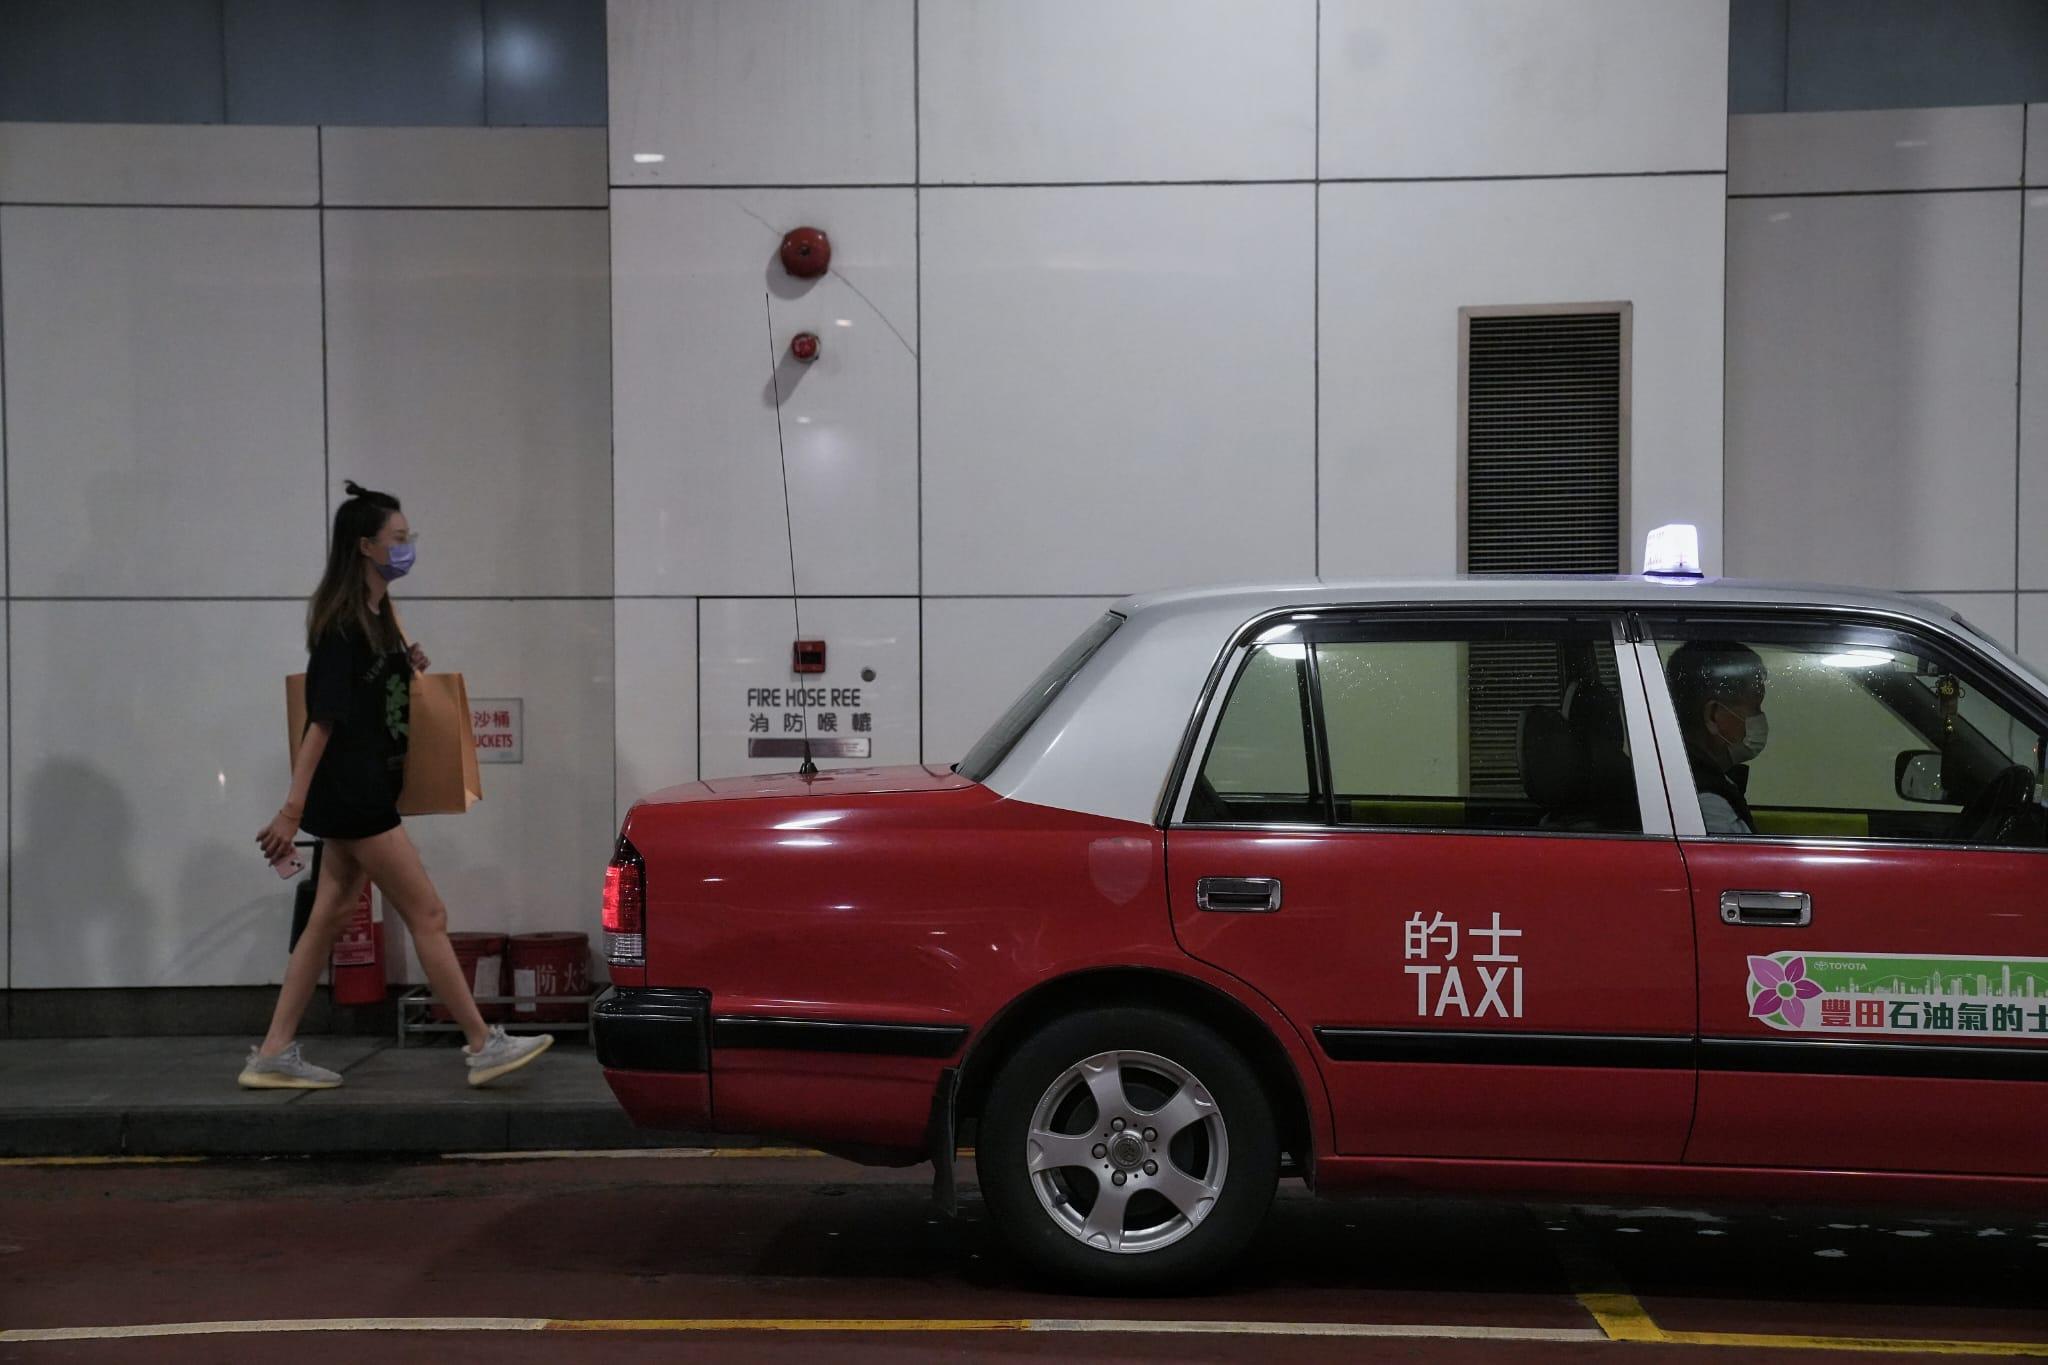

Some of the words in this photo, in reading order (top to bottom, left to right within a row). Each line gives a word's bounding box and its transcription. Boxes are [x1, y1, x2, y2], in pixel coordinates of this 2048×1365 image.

[747, 688, 781, 707] FIRE
[785, 688, 826, 707] HOSE
[831, 688, 861, 707] REE
[474, 710, 510, 728] 沙桶
[474, 734, 513, 748] UCKETS
[1405, 911, 1522, 963] 的士
[1829, 962, 1868, 971] TOYOTA
[1404, 965, 1523, 1018] TAXI
